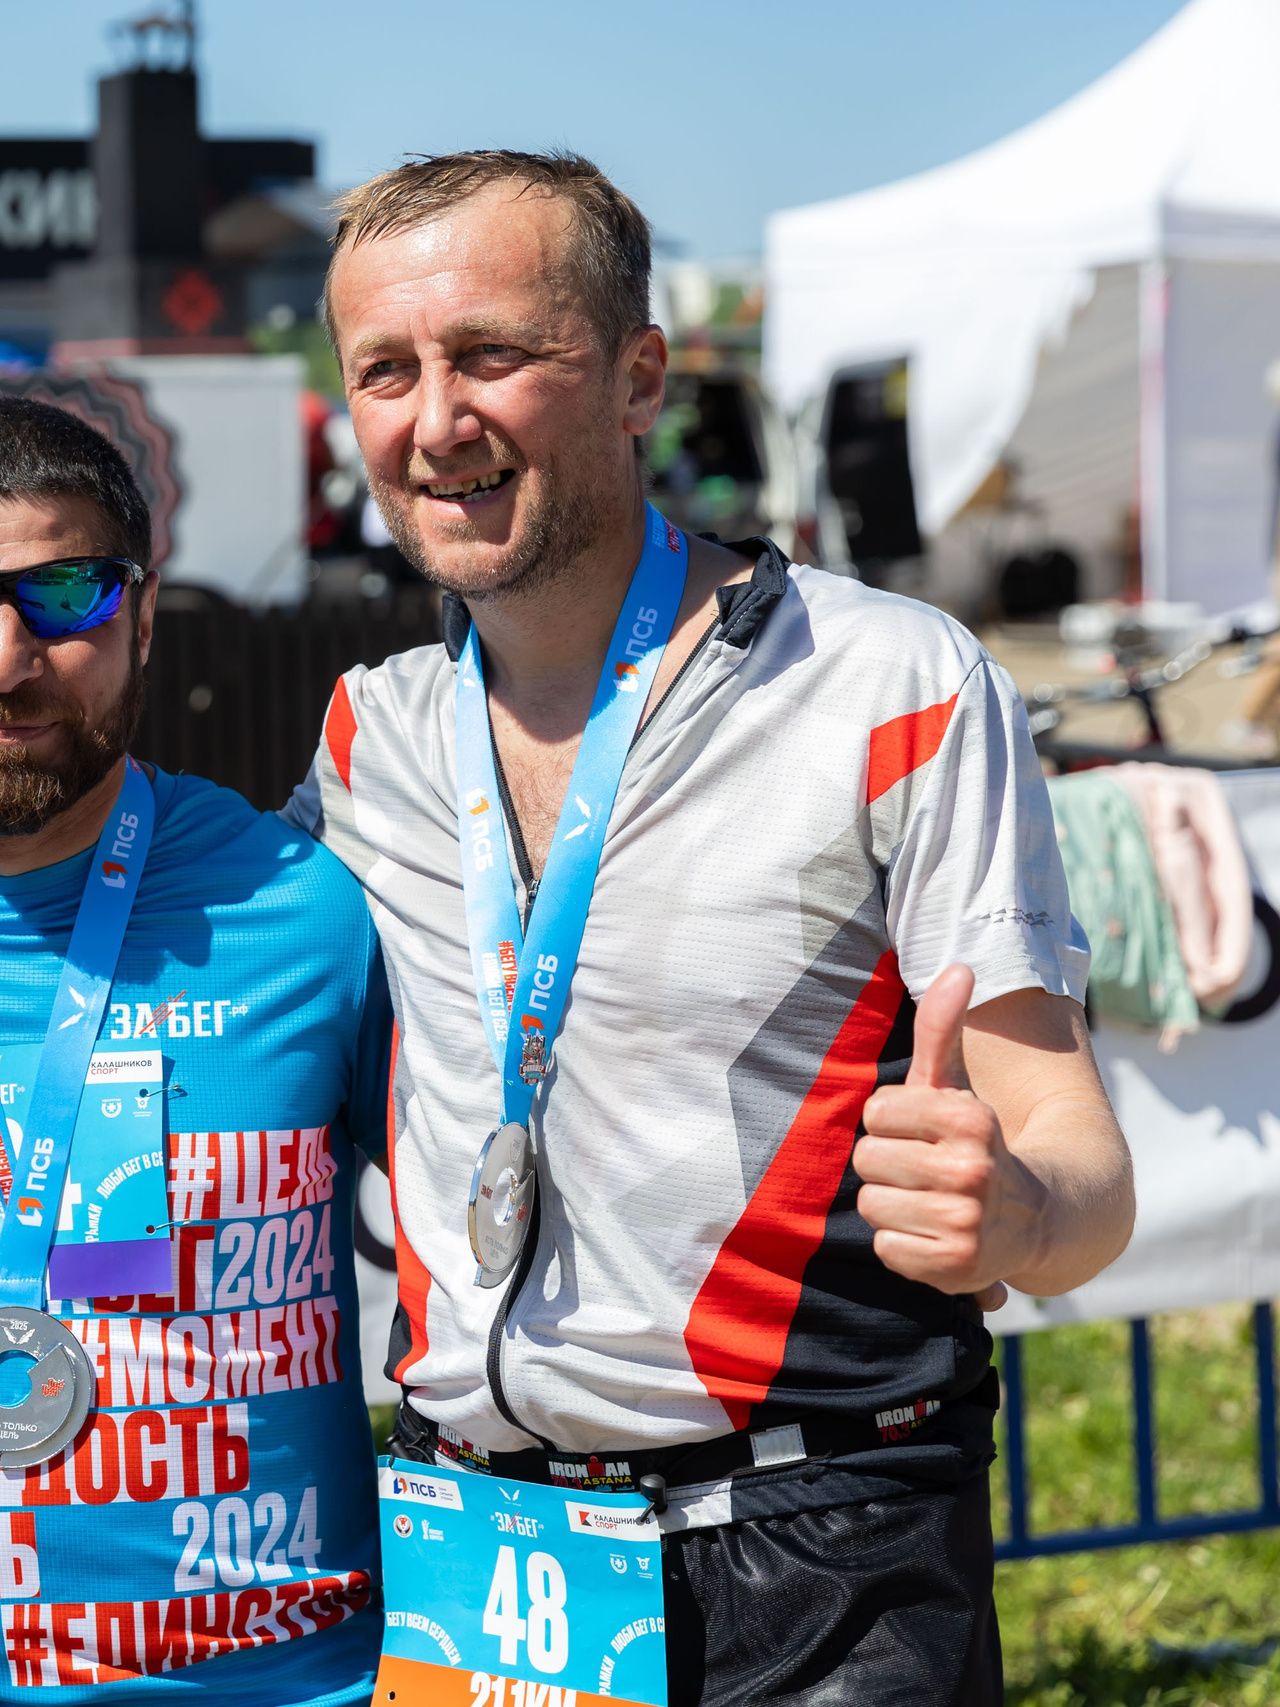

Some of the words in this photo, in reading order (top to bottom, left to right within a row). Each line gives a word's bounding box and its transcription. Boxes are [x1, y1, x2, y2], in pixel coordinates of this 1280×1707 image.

[625, 606, 658, 658] ПСБ
[111, 812, 139, 859] ПСБ
[471, 818, 494, 873] ПСБ
[529, 954, 558, 1011] ПСБ
[91, 1059, 153, 1068] КАЛАШНИКОВ
[91, 1067, 119, 1075] СПОРТ
[26, 1138, 55, 1191] ПСБ
[96, 1167, 125, 1199] ЛЮБИ
[124, 1156, 141, 1176] БЕГ
[143, 1154, 151, 1169] В
[167, 1125, 338, 1219] #ЦЕЛЬ
[215, 1204, 335, 1307] 2024
[9, 1320, 28, 1331] 2025
[73, 1294, 340, 1408] #МОМЕНТ
[3, 1421, 38, 1433] ТОЛЬКО
[875, 1398, 941, 1428] IRONMAN
[438, 1436, 458, 1460] 70.3
[458, 1449, 490, 1467] ASTANA
[549, 1456, 631, 1478] IRONMAN
[409, 1482, 437, 1498] ПСБ
[583, 1476, 632, 1486] ASTANA
[172, 1487, 321, 1592] 2024
[593, 1513, 651, 1525] КАЛАШНИВ
[595, 1521, 618, 1530] СПОРТ
[482, 1545, 569, 1674] 48
[386, 1611, 407, 1627] БЕГУ
[406, 1612, 431, 1633] ВСЕМ
[429, 1621, 462, 1666] СЕРДЦЕМ
[610, 1623, 636, 1655] ЛЮБИ
[632, 1617, 649, 1637] БЕГ
[650, 1617, 657, 1633] В
[599, 1655, 615, 1696] РАМКИ
